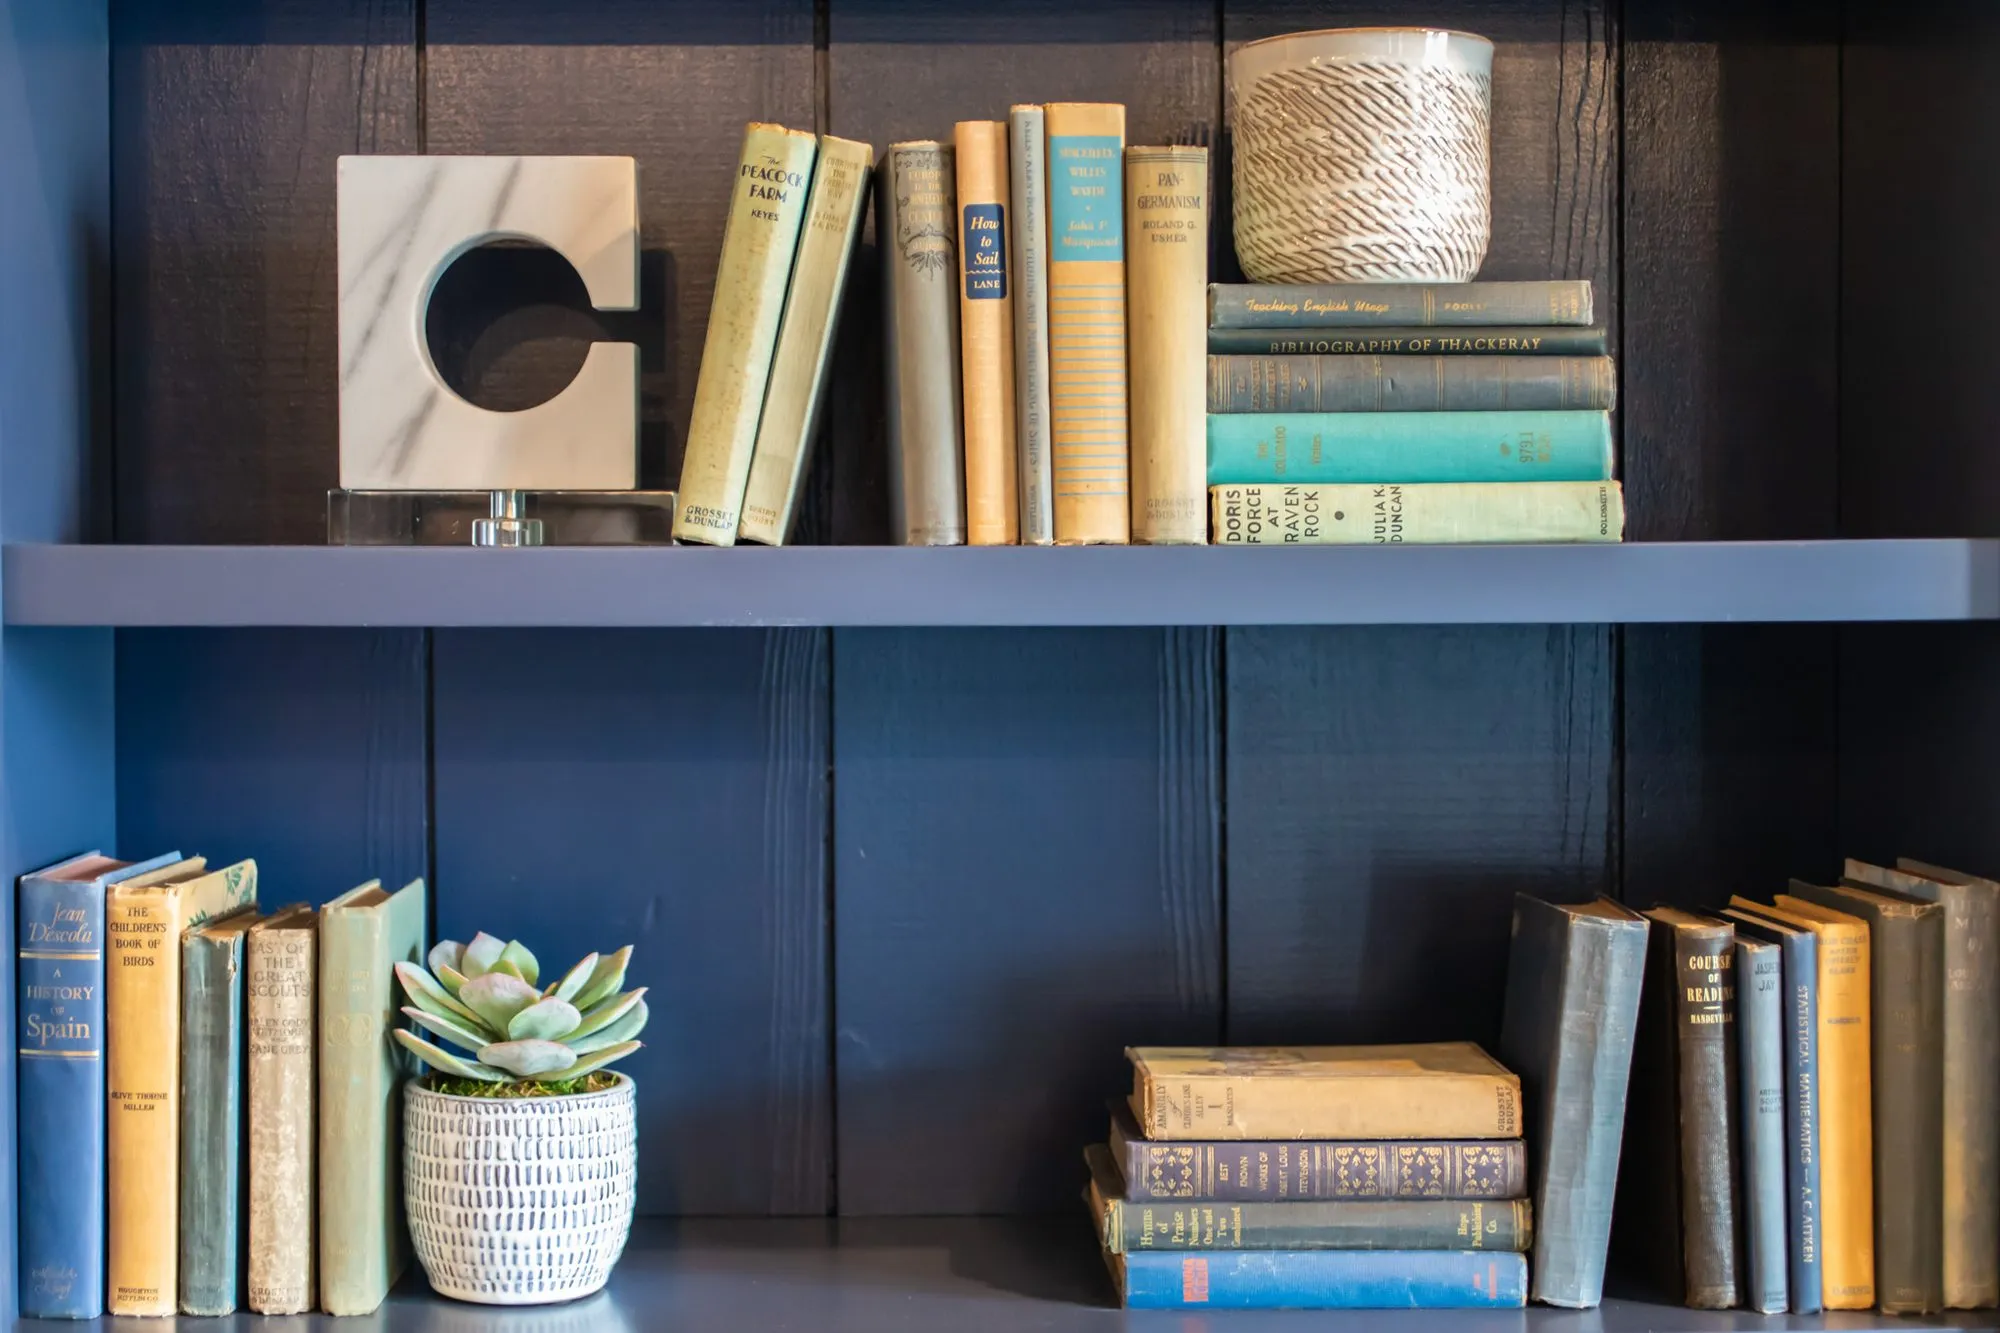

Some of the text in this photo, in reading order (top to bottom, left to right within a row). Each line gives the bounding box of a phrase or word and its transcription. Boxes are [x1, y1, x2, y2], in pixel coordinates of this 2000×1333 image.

[741, 164, 804, 188] PEACOCK
[1157, 173, 1185, 187] PAN-
[749, 184, 788, 203] FARM
[1137, 195, 1201, 210] GERMANISM
[751, 208, 780, 222] KEYES
[971, 217, 999, 230] How
[1142, 221, 1183, 230] ROLAND
[981, 236, 992, 247] to
[1151, 234, 1187, 243] USHER
[974, 252, 999, 265] Sail
[974, 280, 1000, 288] LANE
[1245, 299, 1389, 316] Teaching English Usage
[1270, 337, 1541, 353] BIBLIOGRAPHY OF THACKERAY
[686, 505, 735, 521] GROSSET
[1226, 490, 1242, 543] DORIS
[1247, 488, 1262, 544] FORCE
[1268, 506, 1280, 528] AT
[1285, 487, 1300, 543] RAVEN
[1304, 491, 1320, 538] ROCK
[1374, 485, 1386, 544] JULIA K.
[1390, 486, 1402, 543] DUNCAN
[51, 902, 87, 928] Jean
[126, 907, 148, 917] THE
[28, 922, 92, 943] Descola
[110, 923, 167, 933] CHILDREN'S
[115, 940, 161, 949] BOOK OF
[123, 957, 155, 966] BIRDS
[263, 957, 295, 969] THE
[1689, 955, 1732, 970] COURSE
[53, 968, 62, 978] A
[254, 970, 305, 982] GREAT
[1708, 973, 1719, 983] OF
[27, 985, 94, 1001] HISTORY
[249, 985, 310, 997] SCOUTS
[1759, 979, 1775, 991] JAY
[27, 1014, 91, 1045] Spain
[1797, 984, 1809, 1067] STATISTICAL
[281, 1045, 308, 1054] GREY
[111, 1091, 167, 1100] OLIVE THORNE
[123, 1103, 155, 1111] MILLER
[1195, 1094, 1204, 1119] ALLEY
[1496, 1085, 1505, 1132] GROSSET
[1799, 1073, 1812, 1164] MATHEMATICS
[1259, 1151, 1268, 1163] OF
[1279, 1146, 1288, 1168] LOUIS
[1240, 1156, 1249, 1187] KNOWN
[1299, 1149, 1308, 1193] STEVENSON
[1140, 1208, 1154, 1246] Hymns
[1156, 1222, 1168, 1234] of
[1172, 1211, 1184, 1243] Praise
[1203, 1208, 1213, 1245] One and
[1217, 1217, 1227, 1238] Two
[1802, 1216, 1813, 1263] AITKEN
